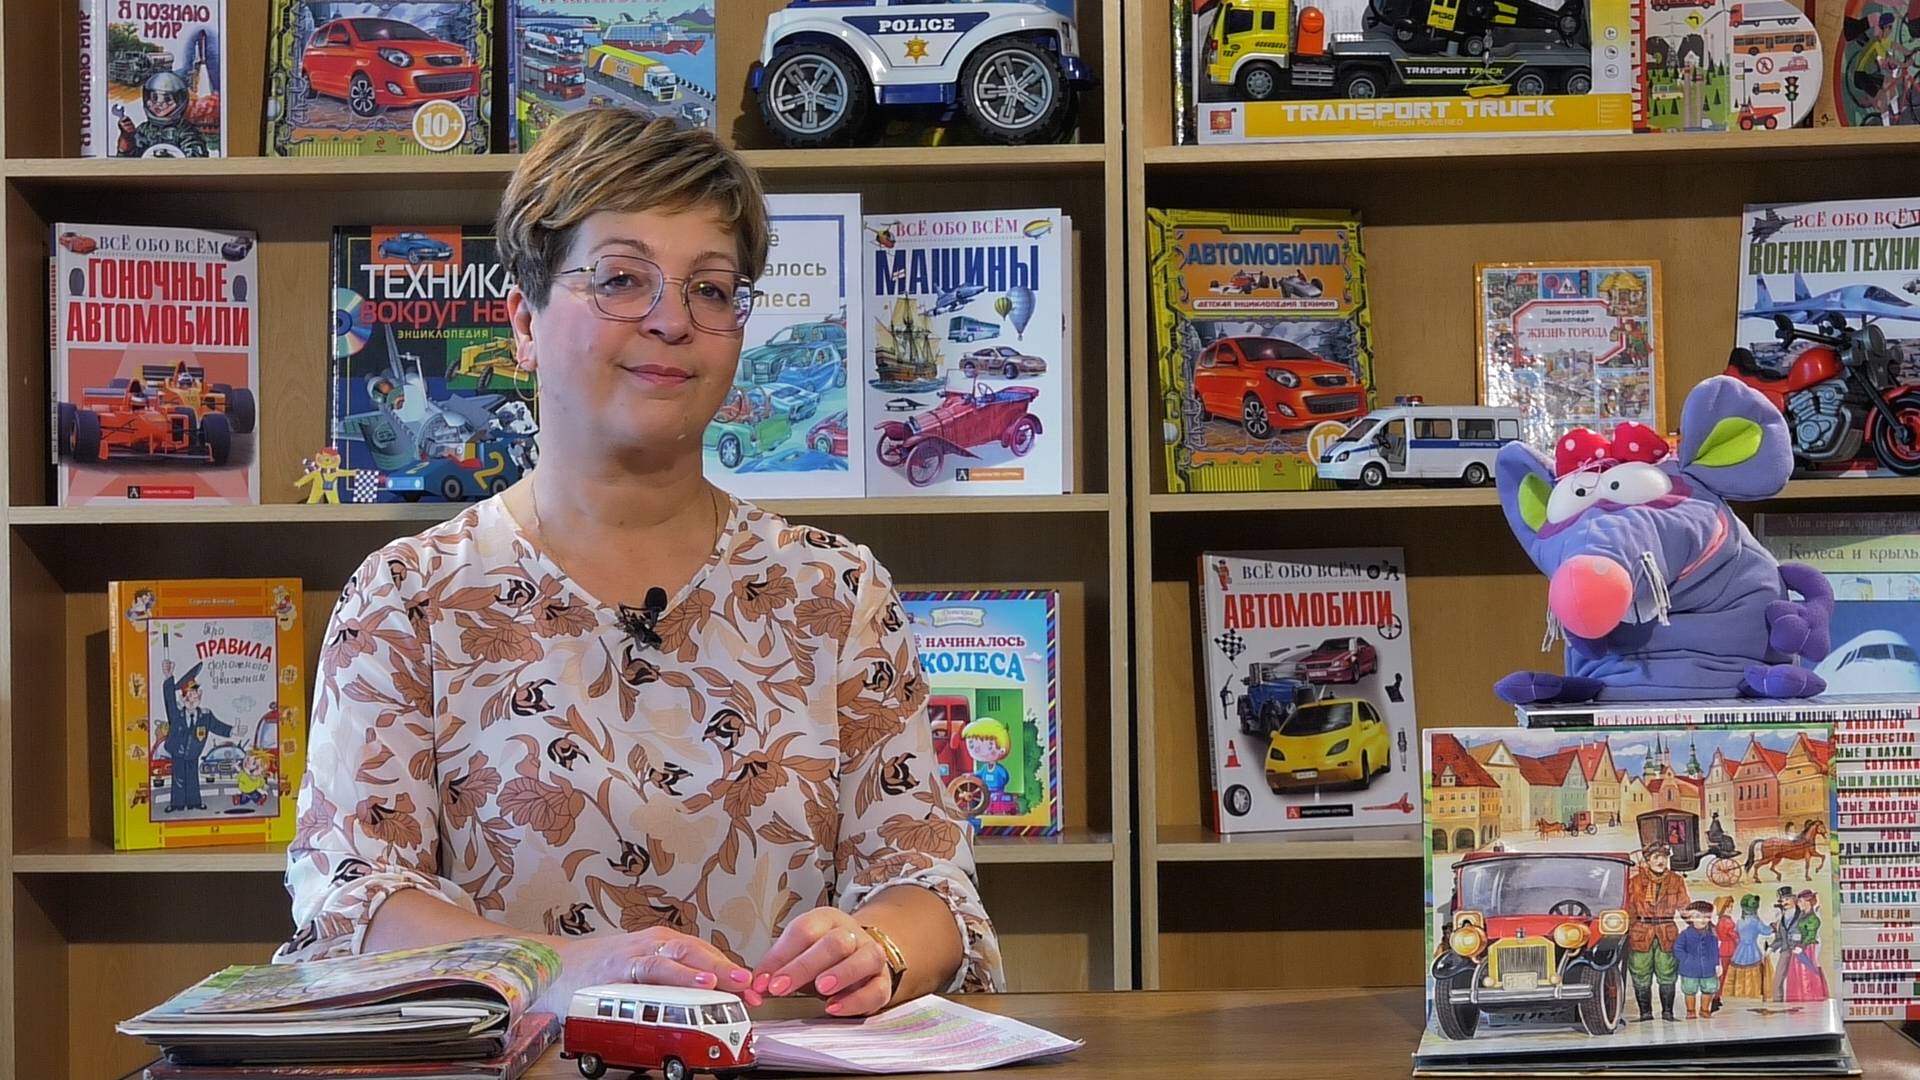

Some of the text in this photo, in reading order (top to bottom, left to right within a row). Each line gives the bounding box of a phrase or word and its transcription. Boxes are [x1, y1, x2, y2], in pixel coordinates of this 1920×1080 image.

[118, 0, 210, 22] Я ПОЗНАЮ
[143, 21, 182, 39] МИР
[878, 18, 955, 32] POLICE
[1281, 99, 1555, 122] TRANSPORT TRUCK
[420, 111, 462, 138] 10+
[895, 216, 1018, 237] ВСЁ ОБО ВСЁМ
[1793, 211, 1827, 228] ВСЁ
[1832, 212, 1868, 226] ОБО
[100, 234, 219, 255] ВСЁ ОБО ВСЁМ
[1186, 242, 1341, 266] АВТОМОБИЛИ
[1749, 237, 1920, 275] ВОЕННАЯ ТЕХНИ
[764, 262, 827, 276] алось
[875, 245, 1040, 296] МАШИНЫ
[88, 258, 228, 303] ГОНОЧНЫЕ
[757, 292, 811, 307] леса
[360, 300, 508, 328] вокруг на
[66, 302, 250, 346] АВТОМОБИЛИ
[1527, 327, 1608, 338] ЖИЗНЬ ГОРОДА
[397, 329, 489, 340] ЭНЦИКЛОПЕДИЯ
[1788, 543, 1920, 563] Колеса и крыль
[1242, 561, 1361, 579] ВСЁ ОБО ВСЁМ
[1224, 590, 1393, 629] АВТОМОБИЛИ
[195, 638, 273, 663] ПРАВИЛА
[1838, 775, 1864, 787] ЫШИ
[1869, 800, 1919, 811] ЖИВОТНЫ
[1868, 841, 1920, 853] ЖИВОТНЫ
[1842, 867, 1870, 879] ТНЫЕ
[1860, 909, 1911, 920] МЕДВЕДИ
[1877, 932, 1914, 943] АКУЛЫ
[1853, 983, 1898, 995] ЛОШАДИ
[1848, 1006, 1894, 1016] ЭНЕРГИЯ
